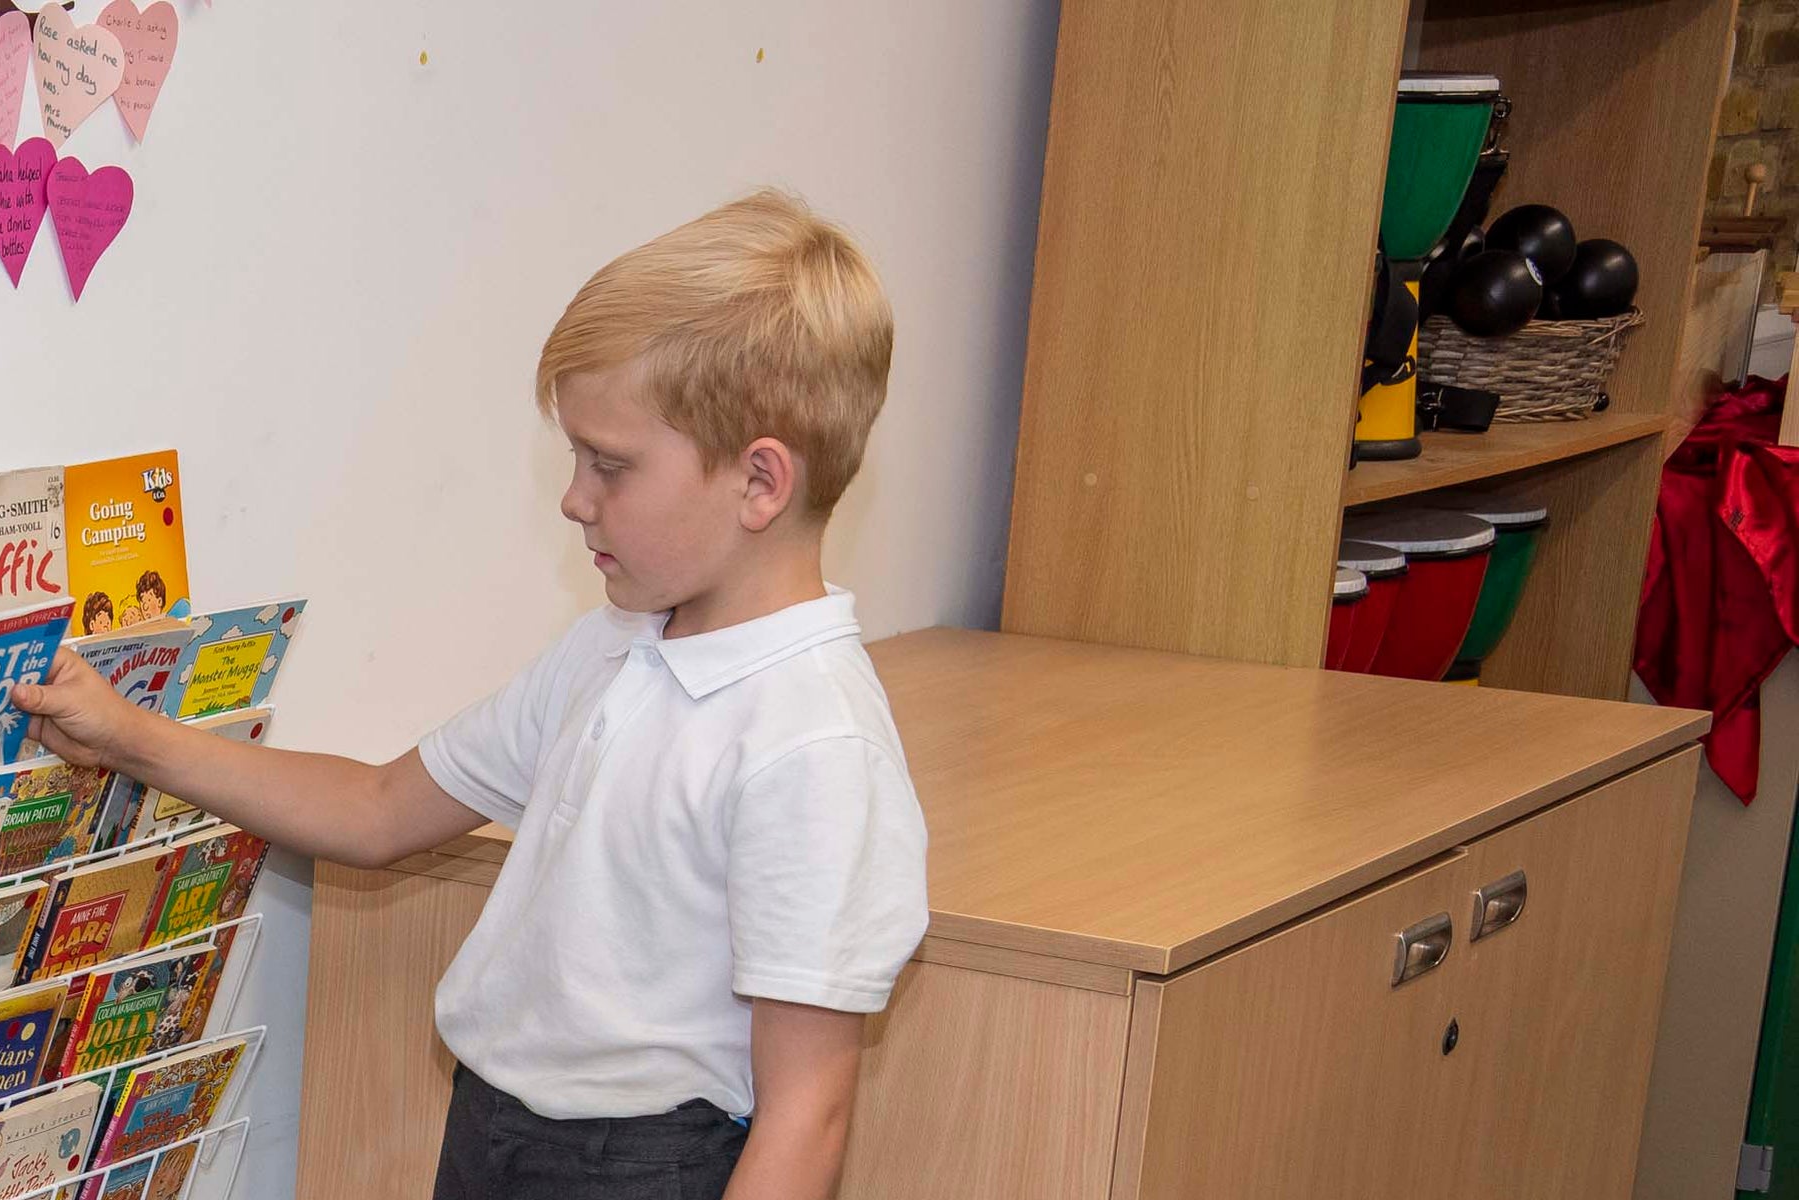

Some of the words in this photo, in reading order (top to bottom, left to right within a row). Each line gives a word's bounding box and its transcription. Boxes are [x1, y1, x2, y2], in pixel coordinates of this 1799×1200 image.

[39, 16, 58, 40] Rose
[67, 35, 97, 56] asked
[103, 54, 118, 67] me
[56, 60, 70, 86] my
[76, 64, 96, 95] day
[7, 215, 31, 232] drinks
[141, 466, 173, 493] Kids
[90, 499, 133, 520] Going
[82, 521, 146, 546] Camping
[28, 641, 44, 654] in
[22, 656, 48, 672] the
[222, 656, 235, 665] The
[191, 671, 225, 686] Monster
[226, 662, 259, 679] Muggs
[3, 811, 31, 826] BRIAN
[31, 804, 62, 821] PATTEN
[170, 882, 217, 916] ART
[70, 908, 91, 925] ANNE
[91, 903, 108, 919] FINE
[51, 921, 111, 957] CARE
[76, 1011, 158, 1053] JOLLY
[11, 1153, 50, 1180] Jack's
